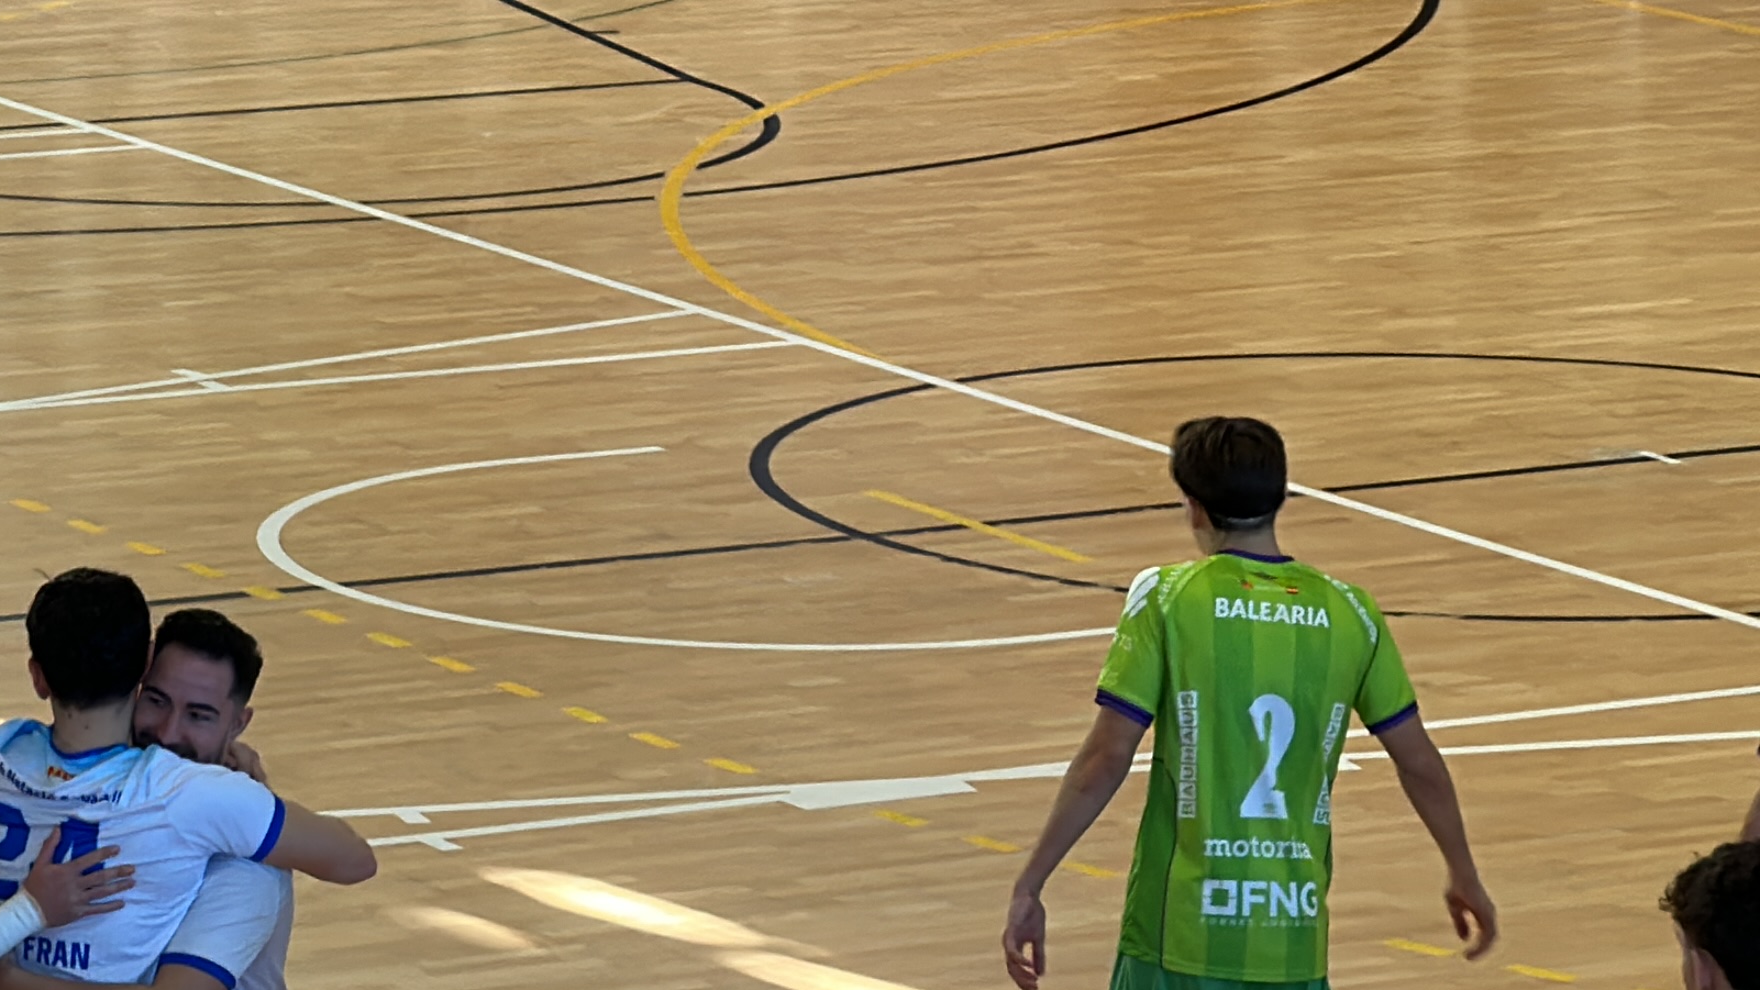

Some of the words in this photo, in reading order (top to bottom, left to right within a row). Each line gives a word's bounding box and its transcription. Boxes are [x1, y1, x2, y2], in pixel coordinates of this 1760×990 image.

[1214, 597, 1330, 629] BALEARIA
[1177, 689, 1198, 819] BAUHAUS
[1240, 693, 1295, 819] 2
[1242, 880, 1319, 918] FNG
[23, 935, 90, 970] FRAN
